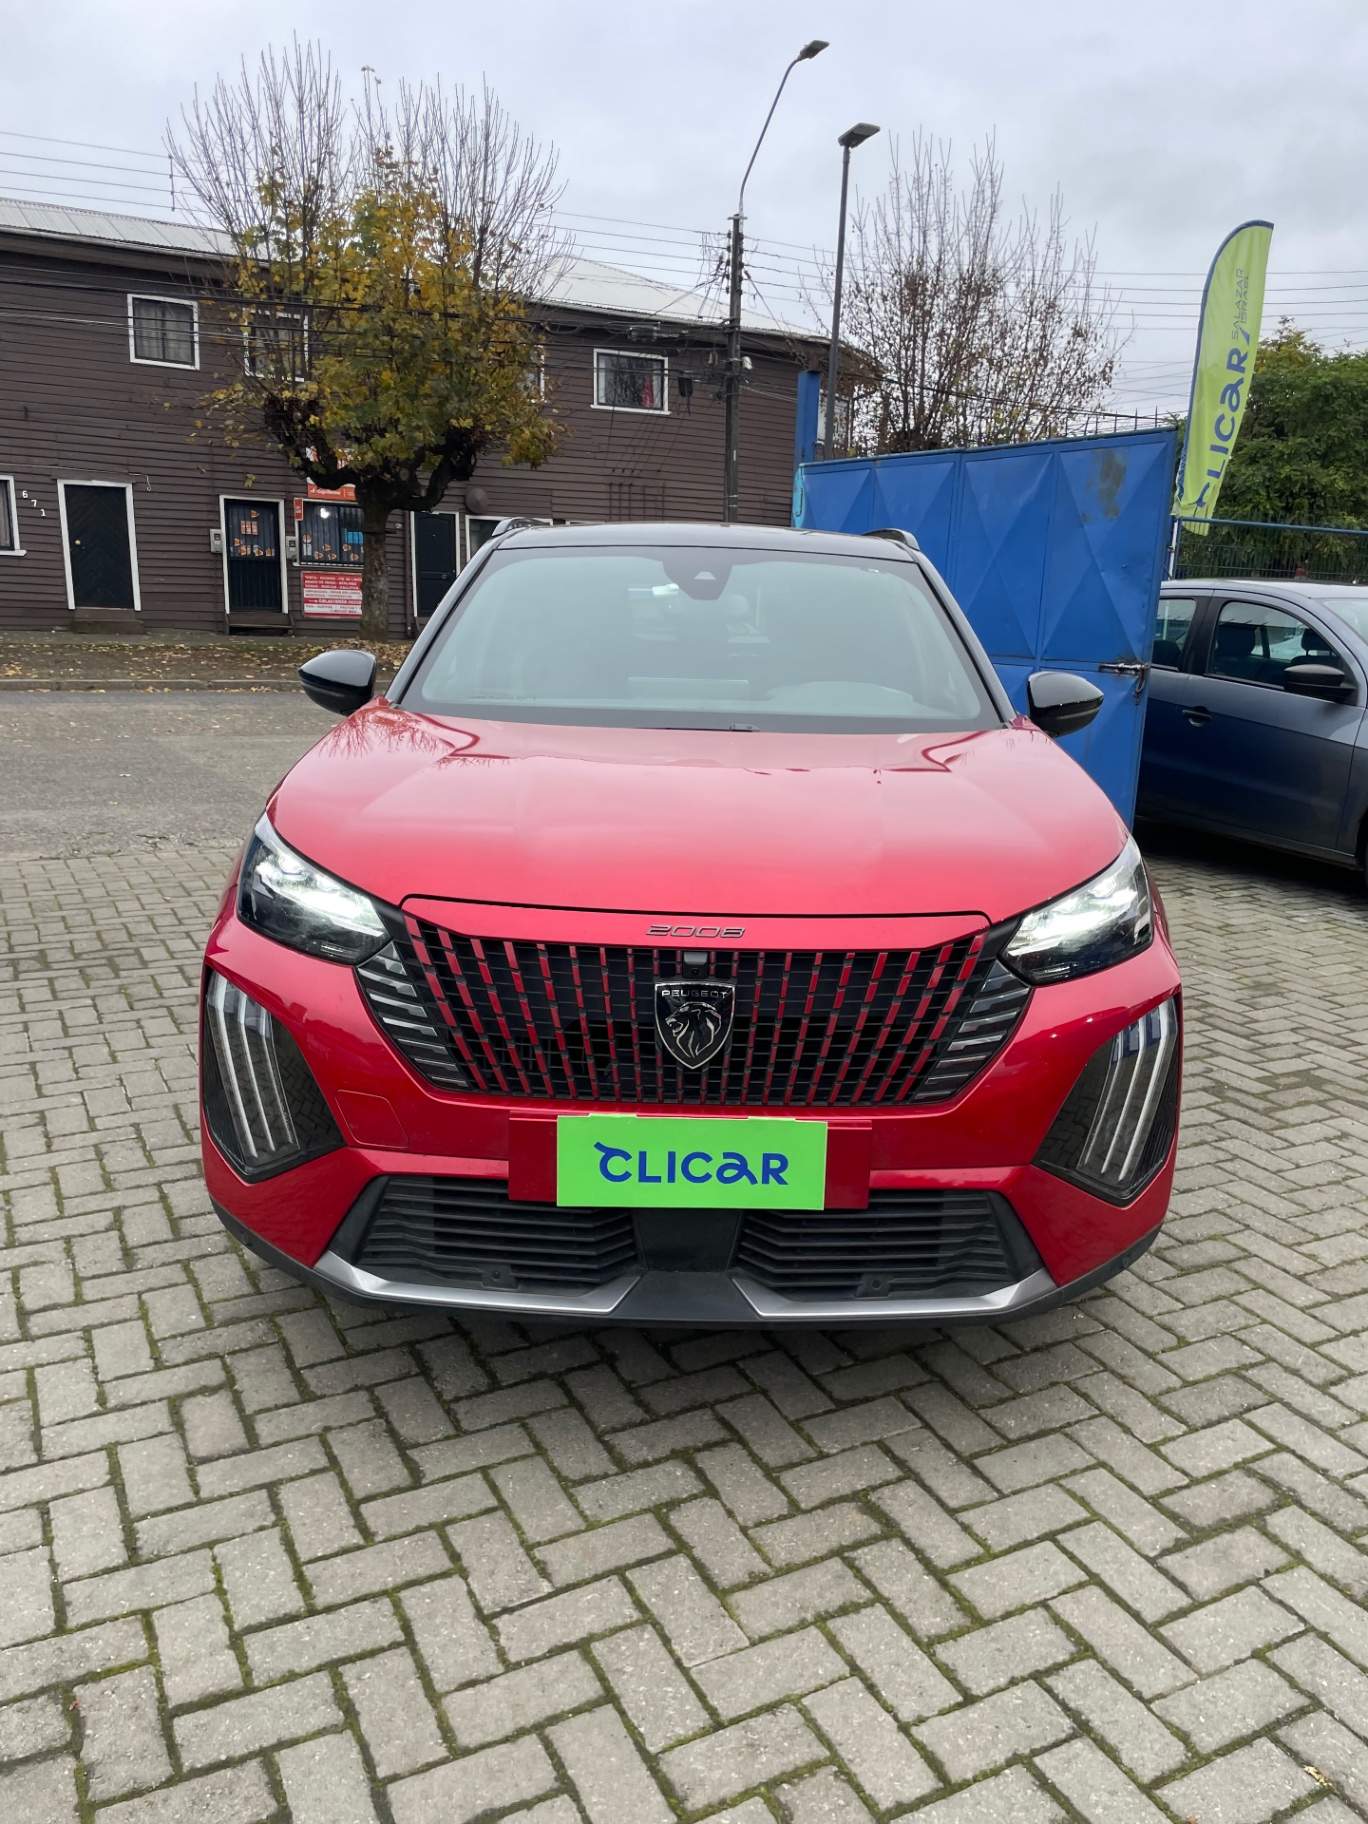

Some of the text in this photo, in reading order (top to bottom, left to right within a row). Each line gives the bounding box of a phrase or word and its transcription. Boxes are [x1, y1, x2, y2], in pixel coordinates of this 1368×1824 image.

[1232, 268, 1245, 340] SALAZAR
[646, 925, 746, 938] 2008
[661, 989, 729, 998] PEUGEOT
